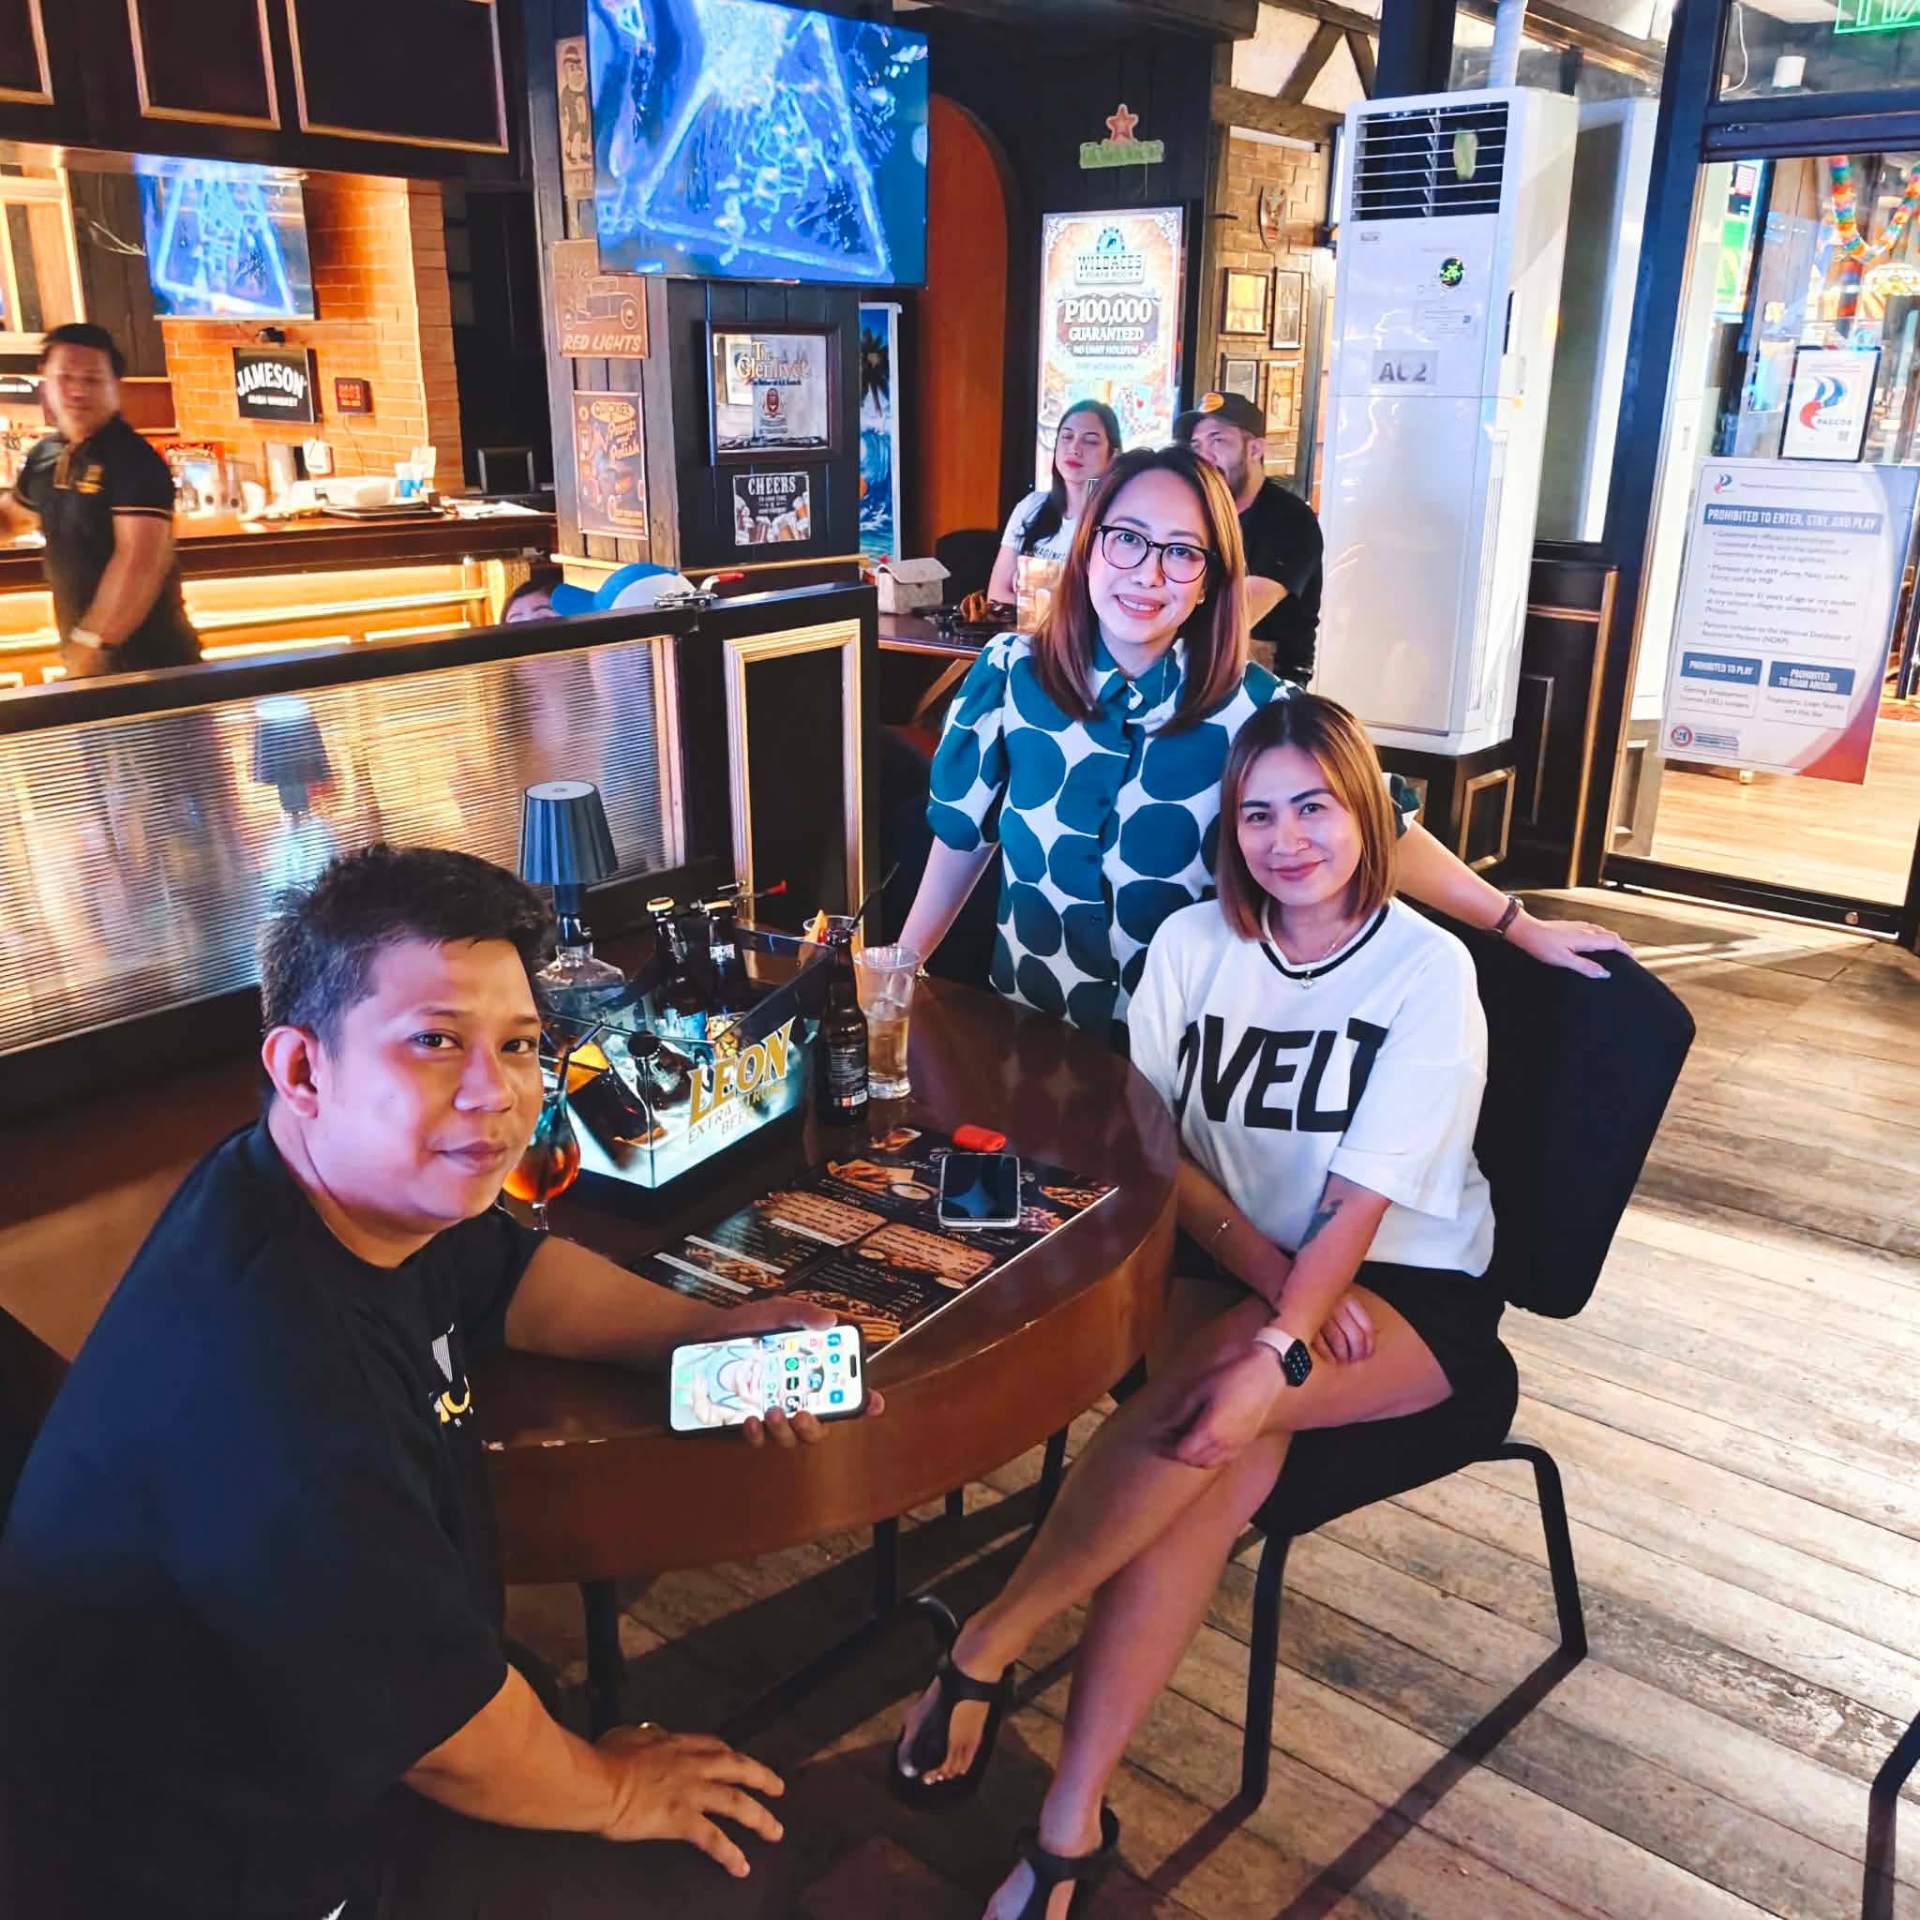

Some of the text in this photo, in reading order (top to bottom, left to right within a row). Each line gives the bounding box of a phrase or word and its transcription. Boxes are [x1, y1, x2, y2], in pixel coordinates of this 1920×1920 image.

[563, 334, 642, 352] RED LIGHTS
[1069, 326, 1143, 341] GUARANTEED
[237, 362, 305, 399] JAMESON
[748, 476, 796, 496] CHEERS
[1708, 508, 1758, 523] PROHIBITED
[1760, 511, 1771, 523] TO
[1853, 517, 1877, 530] PLAY
[687, 1016, 797, 1126] LEON
